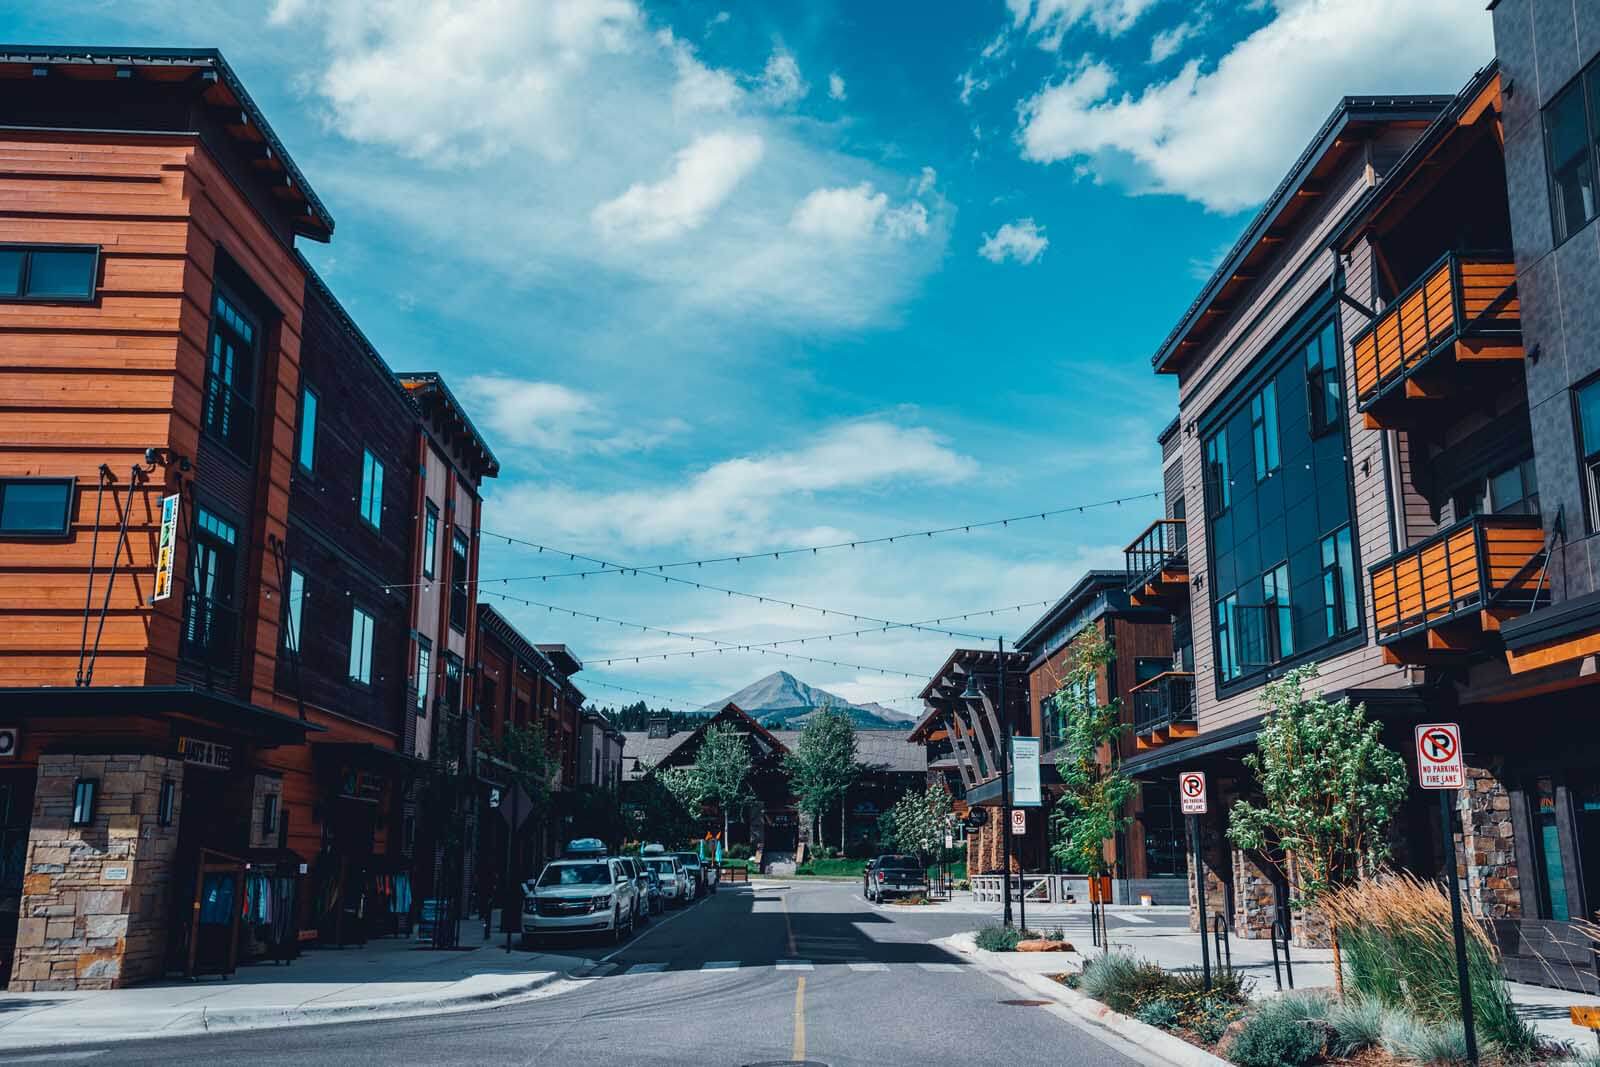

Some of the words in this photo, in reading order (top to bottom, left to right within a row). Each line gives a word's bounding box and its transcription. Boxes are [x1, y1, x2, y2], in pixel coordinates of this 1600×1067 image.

[1433, 765, 1459, 773] PARKING
[1426, 775, 1440, 783] FIRE
[1441, 775, 1457, 783] LANE
